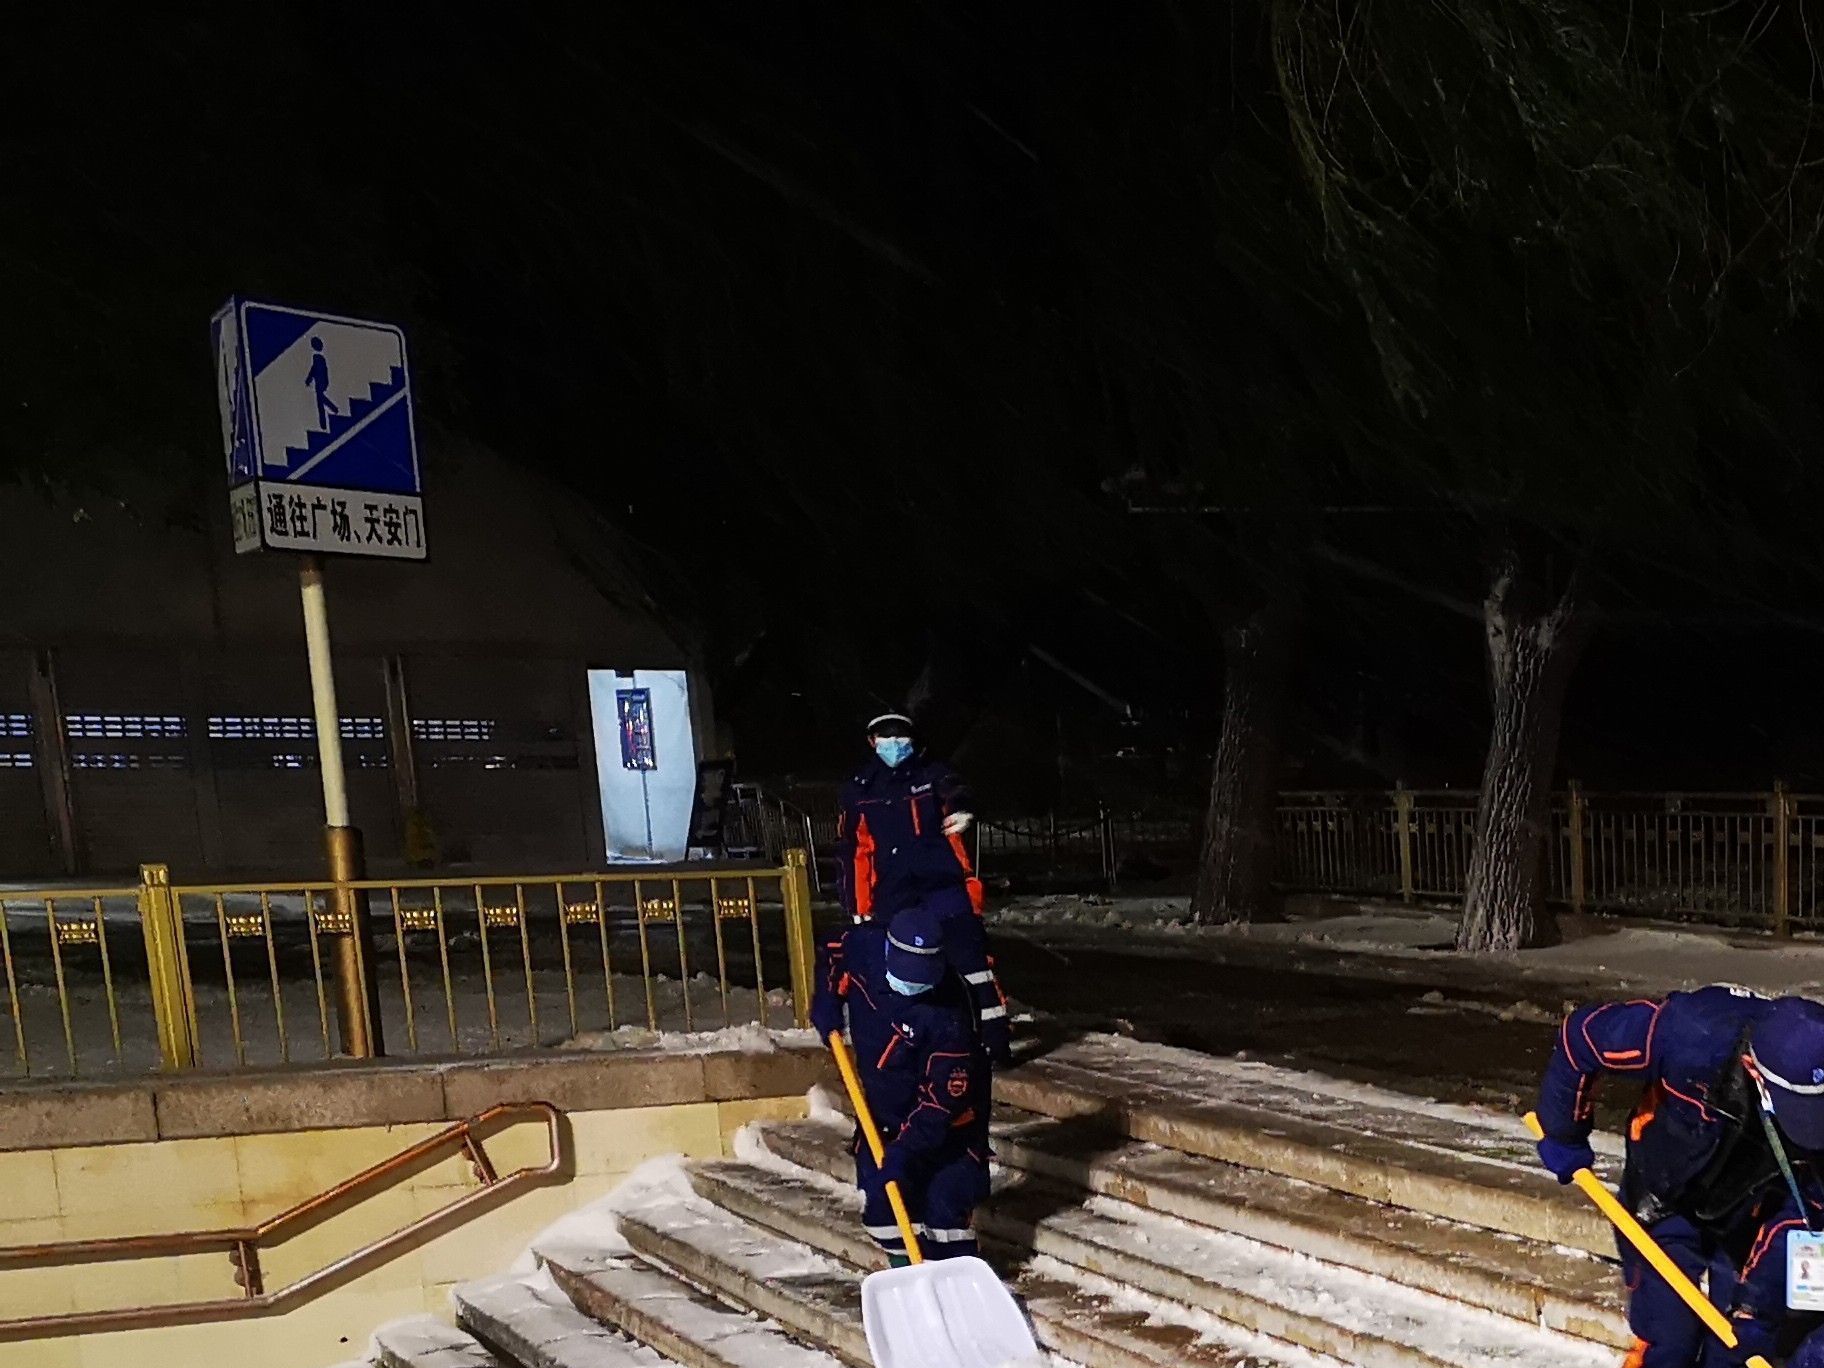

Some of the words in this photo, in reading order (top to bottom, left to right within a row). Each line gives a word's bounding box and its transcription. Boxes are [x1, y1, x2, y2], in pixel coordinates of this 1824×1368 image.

[267, 492, 422, 548] 通往广场、天安门
